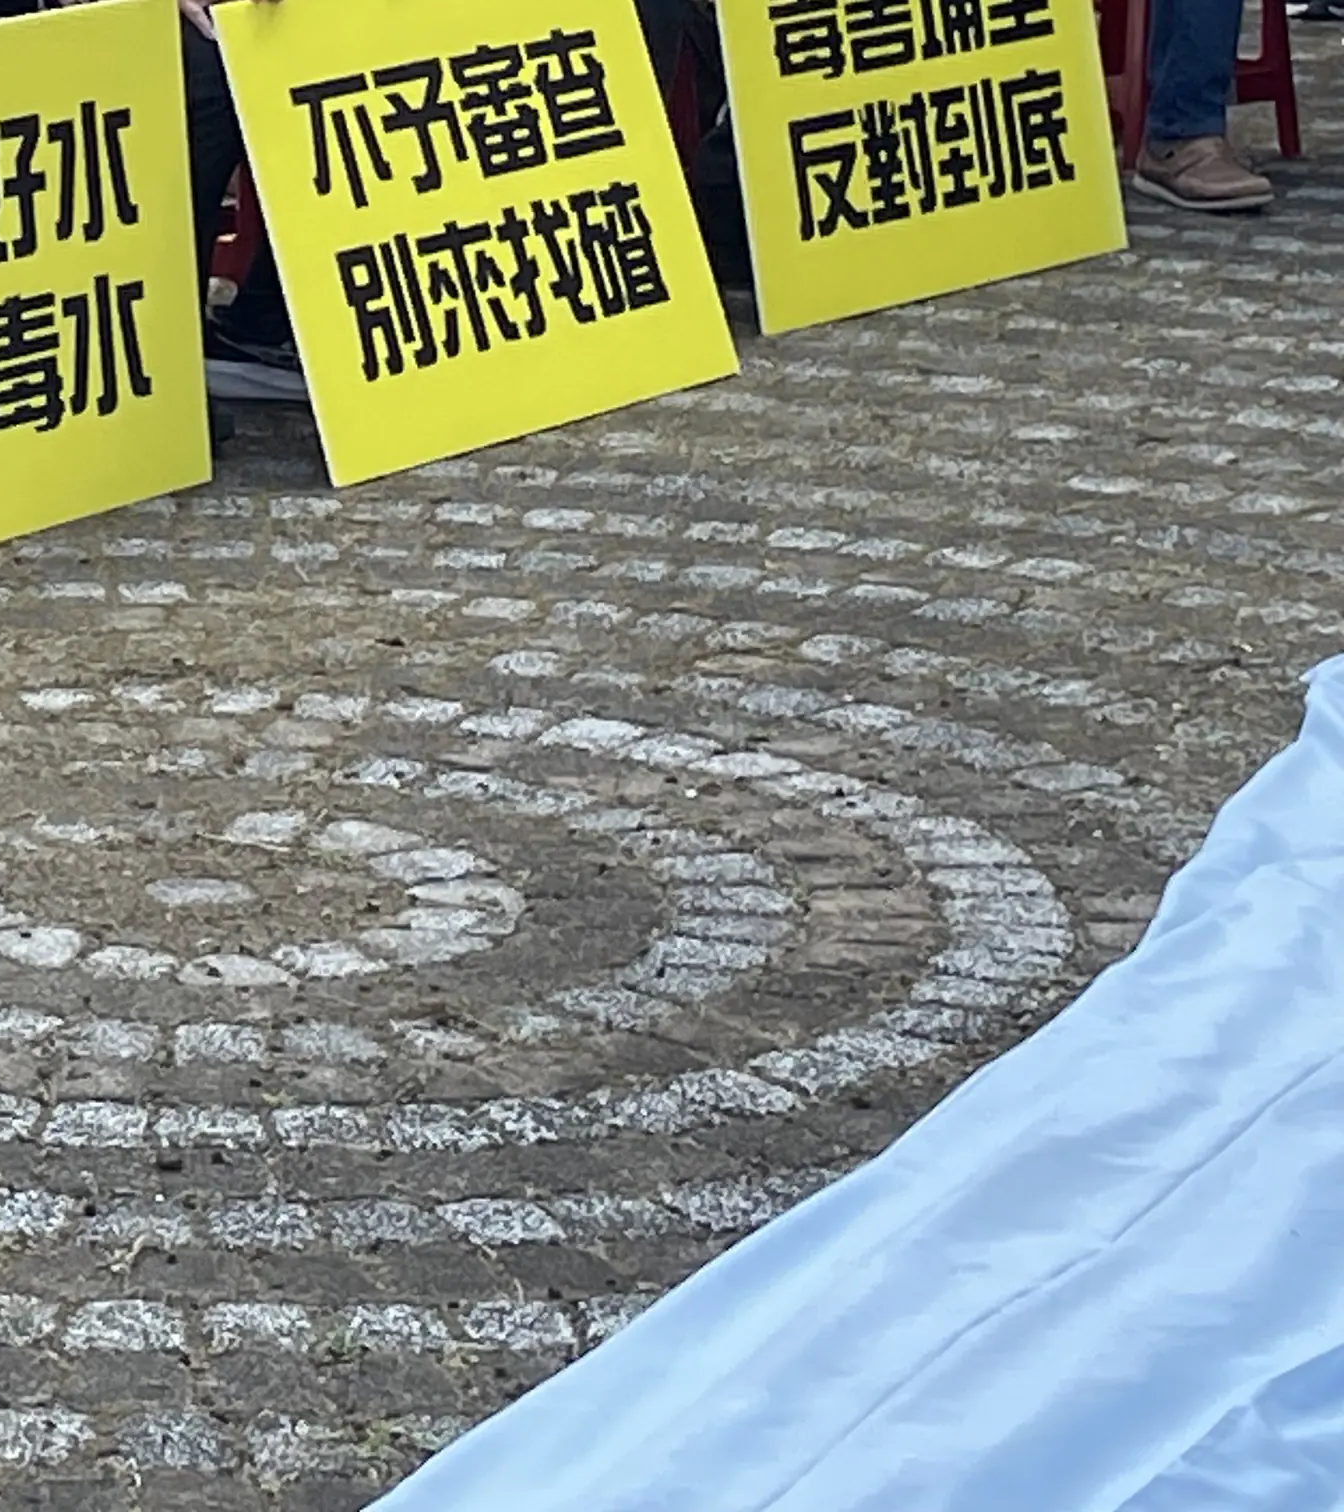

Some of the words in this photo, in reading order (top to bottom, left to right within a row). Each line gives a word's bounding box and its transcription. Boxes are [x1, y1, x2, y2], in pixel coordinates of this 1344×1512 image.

[289, 28, 626, 209] 不予審查
[787, 68, 1076, 242] 反對到底
[335, 181, 671, 383] 別來找碴
